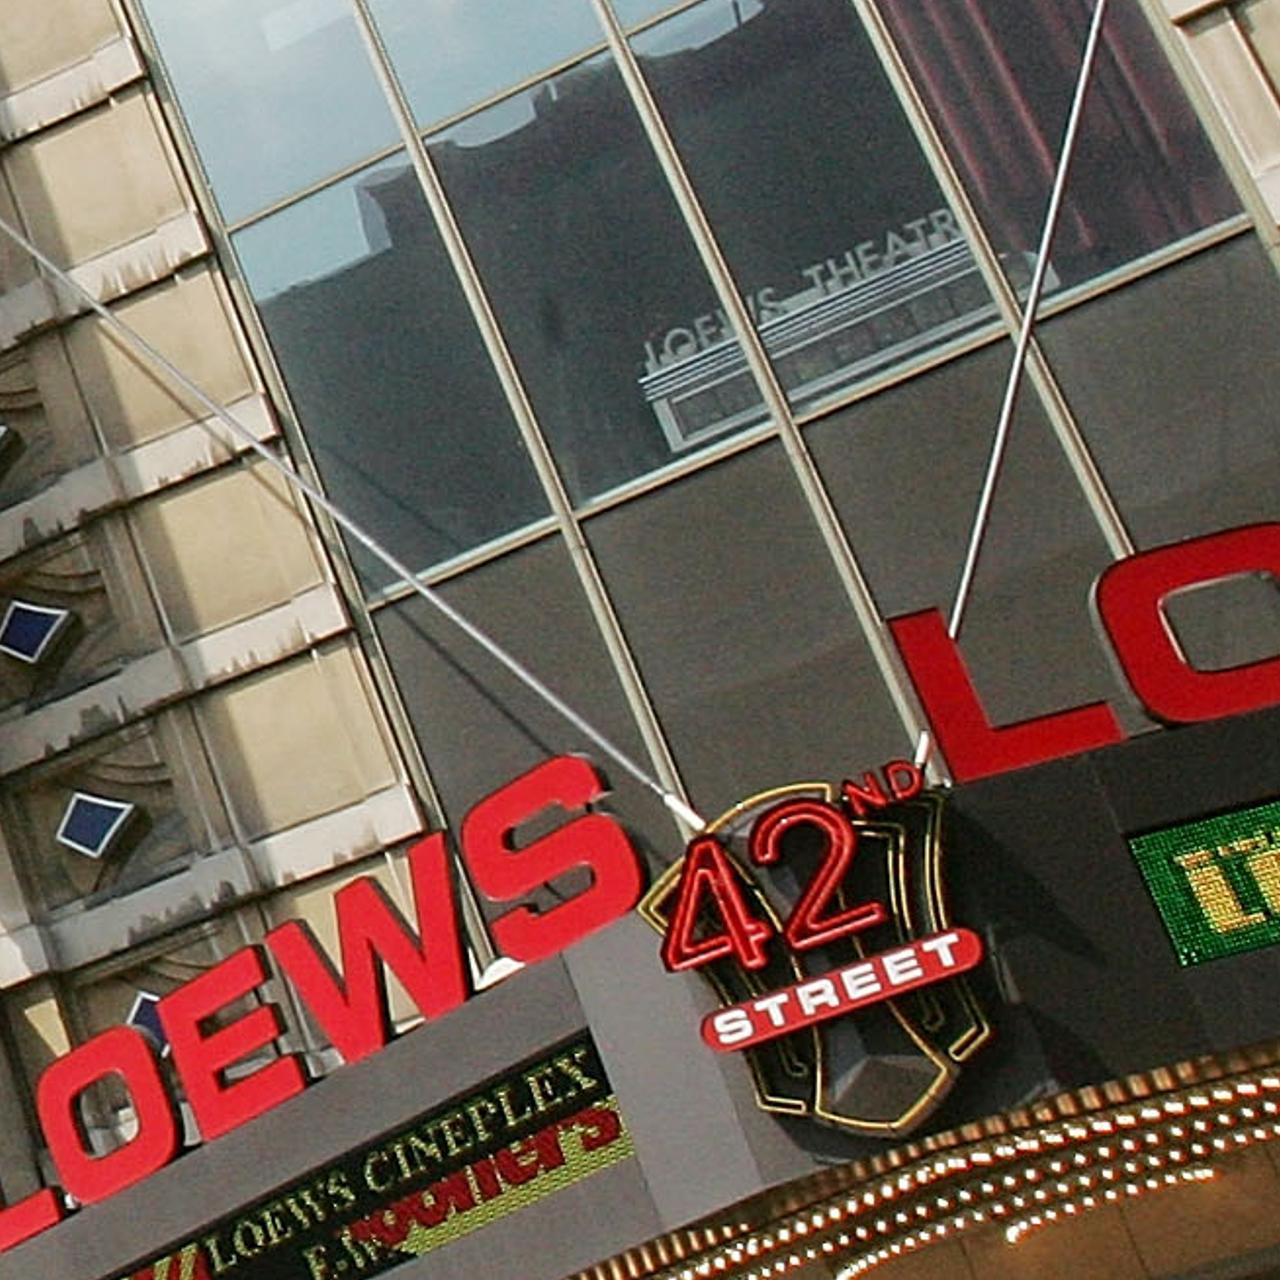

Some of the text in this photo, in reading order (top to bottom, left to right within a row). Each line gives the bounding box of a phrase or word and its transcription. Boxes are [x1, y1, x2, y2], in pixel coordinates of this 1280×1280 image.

[803, 207, 965, 294] THEATR
[712, 932, 960, 1047] STREET
[209, 1168, 354, 1274] LOEWS
[364, 1048, 603, 1196] CINEPLEX
